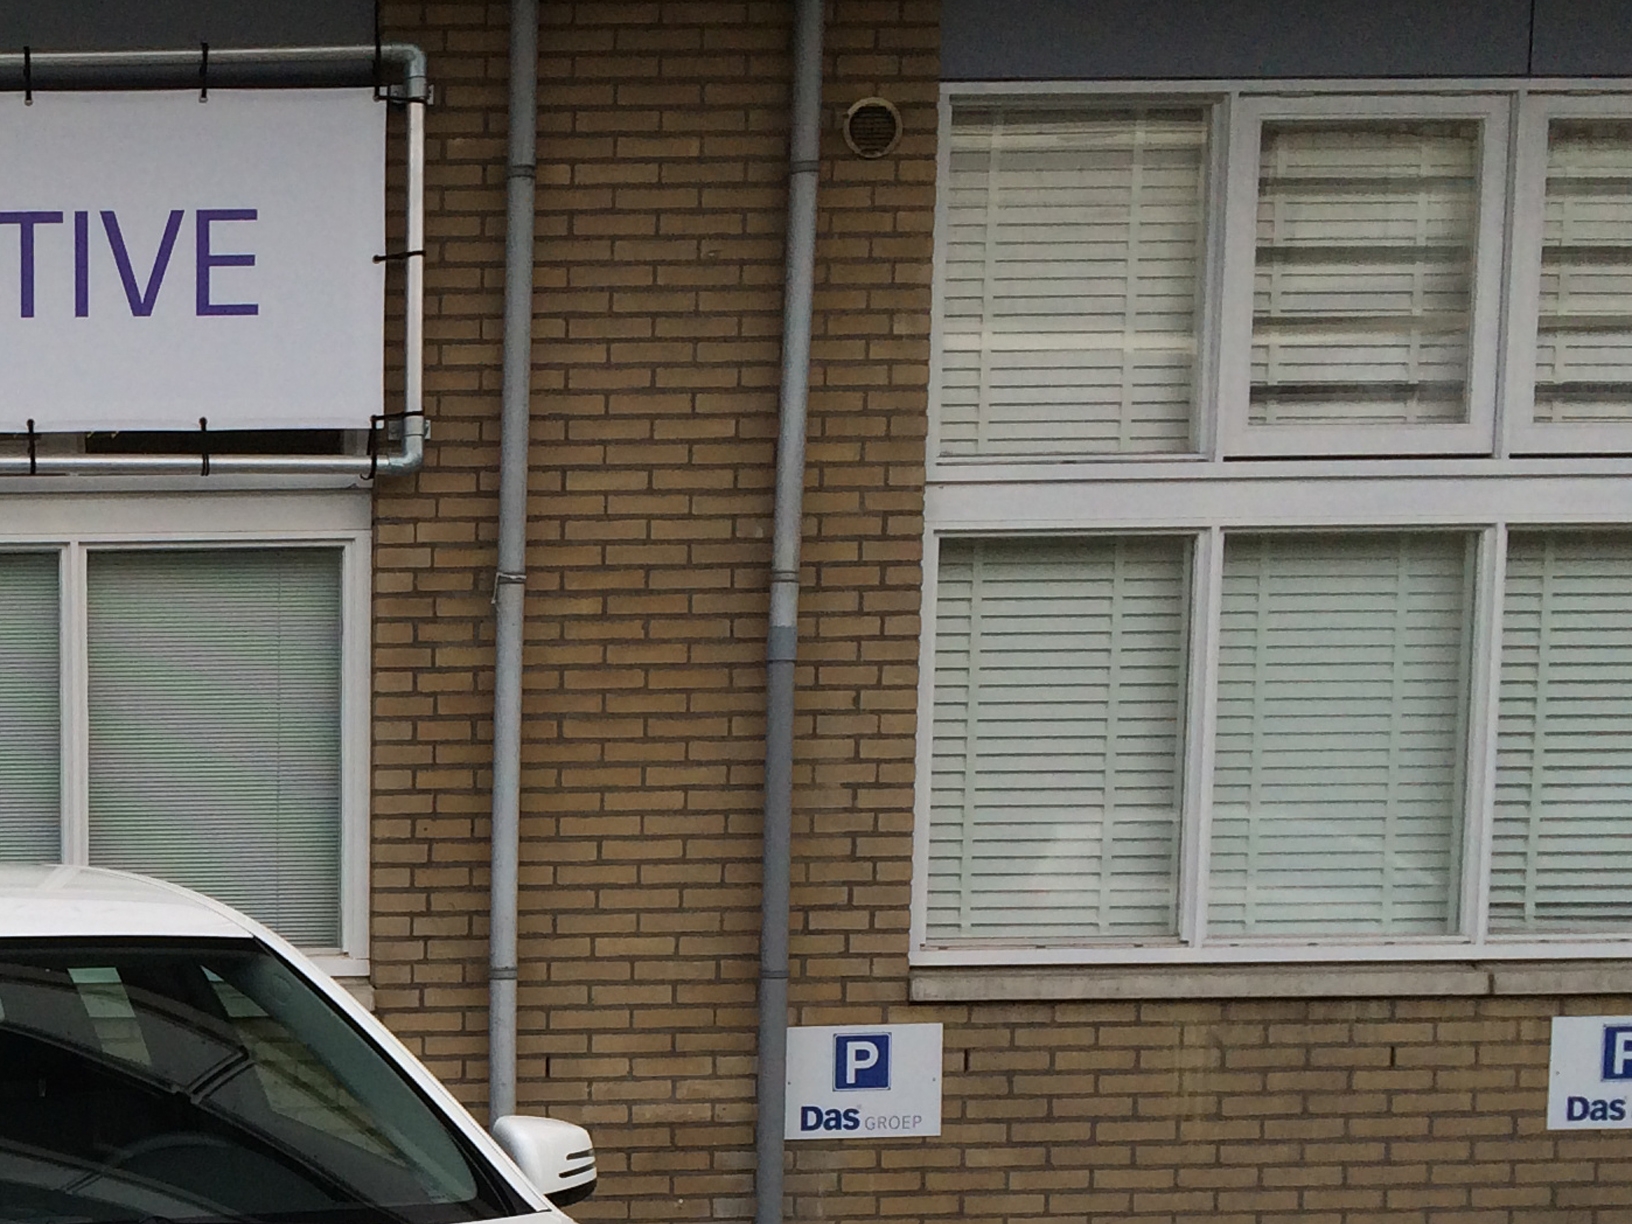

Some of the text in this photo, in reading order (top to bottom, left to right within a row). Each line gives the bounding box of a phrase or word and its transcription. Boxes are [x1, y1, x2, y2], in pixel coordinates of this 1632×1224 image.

[845, 1041, 879, 1084] P
[800, 1106, 923, 1132] Das GROEP
[1567, 1096, 1627, 1122] Das
